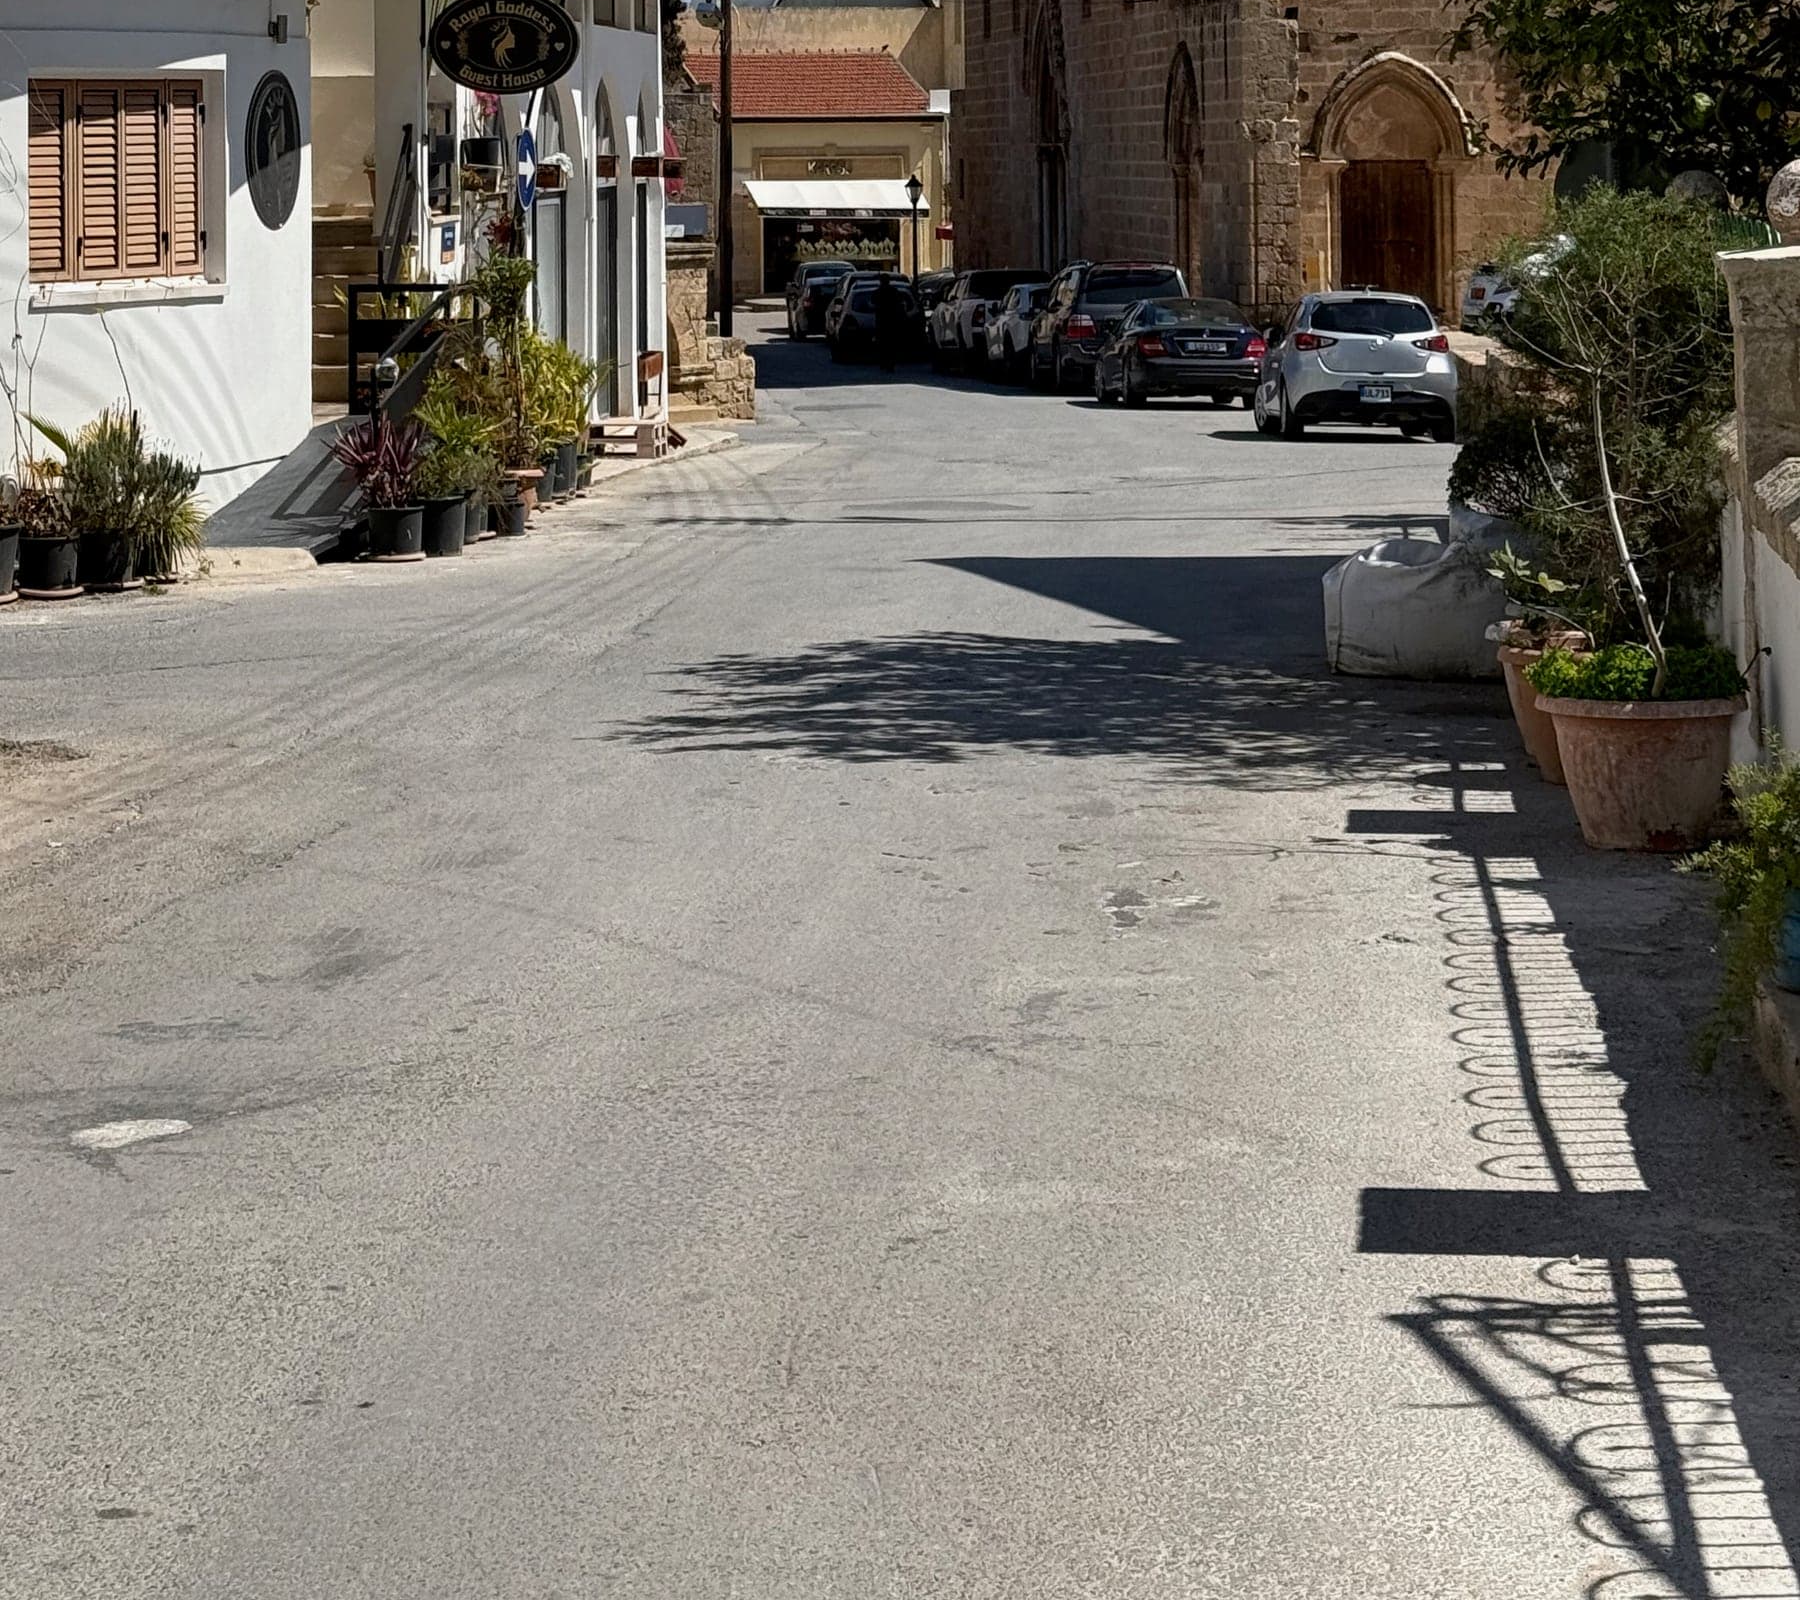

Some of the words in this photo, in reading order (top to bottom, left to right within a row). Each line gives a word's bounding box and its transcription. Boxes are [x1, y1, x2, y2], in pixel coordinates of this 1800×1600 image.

[448, 2, 491, 33] Royal
[495, 0, 557, 34] Goddess
[458, 64, 499, 88] Guest
[502, 67, 546, 88] House
